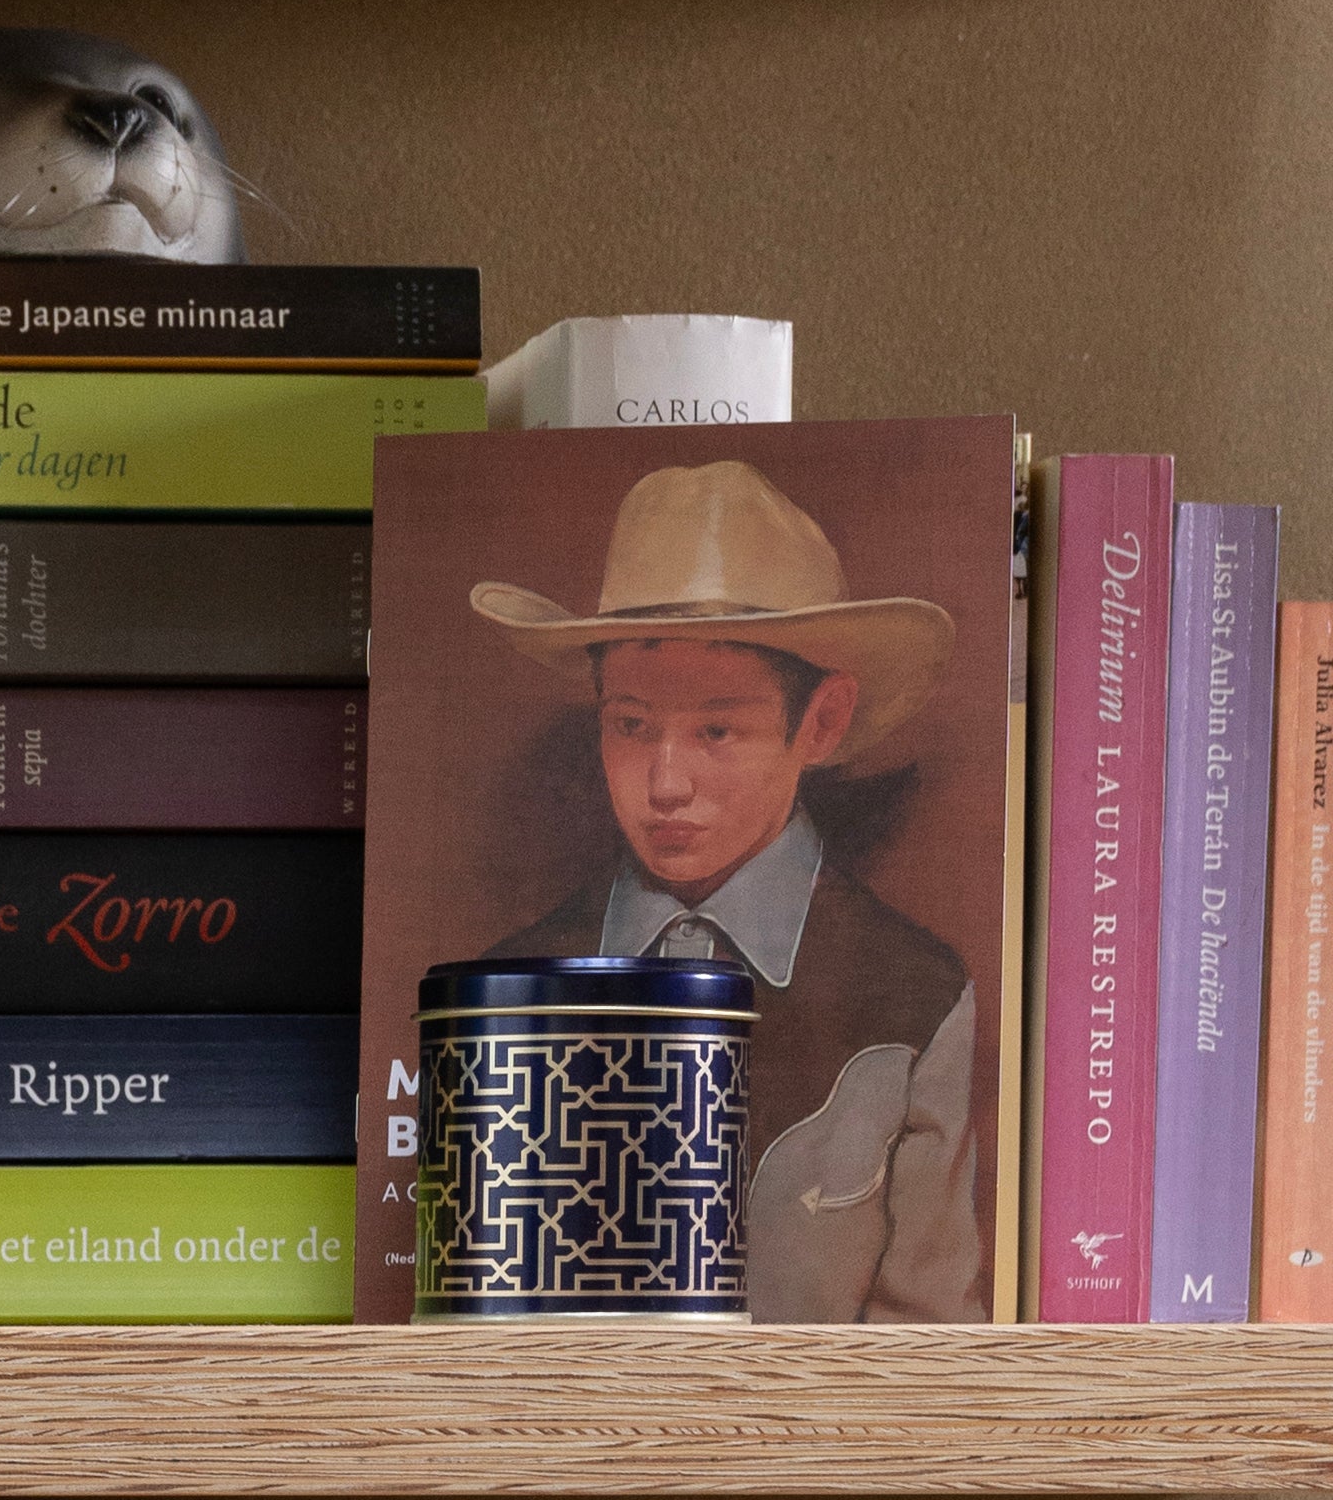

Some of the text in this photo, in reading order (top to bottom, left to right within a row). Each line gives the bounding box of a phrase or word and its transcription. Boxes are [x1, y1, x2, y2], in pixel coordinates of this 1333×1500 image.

[20, 299, 147, 337] Japanse
[156, 301, 291, 331] minnaar
[1087, 531, 1141, 1145] Delirium LAURA RESTREPO
[46, 873, 237, 974] Zorro
[9, 1063, 169, 1114] Ripper
